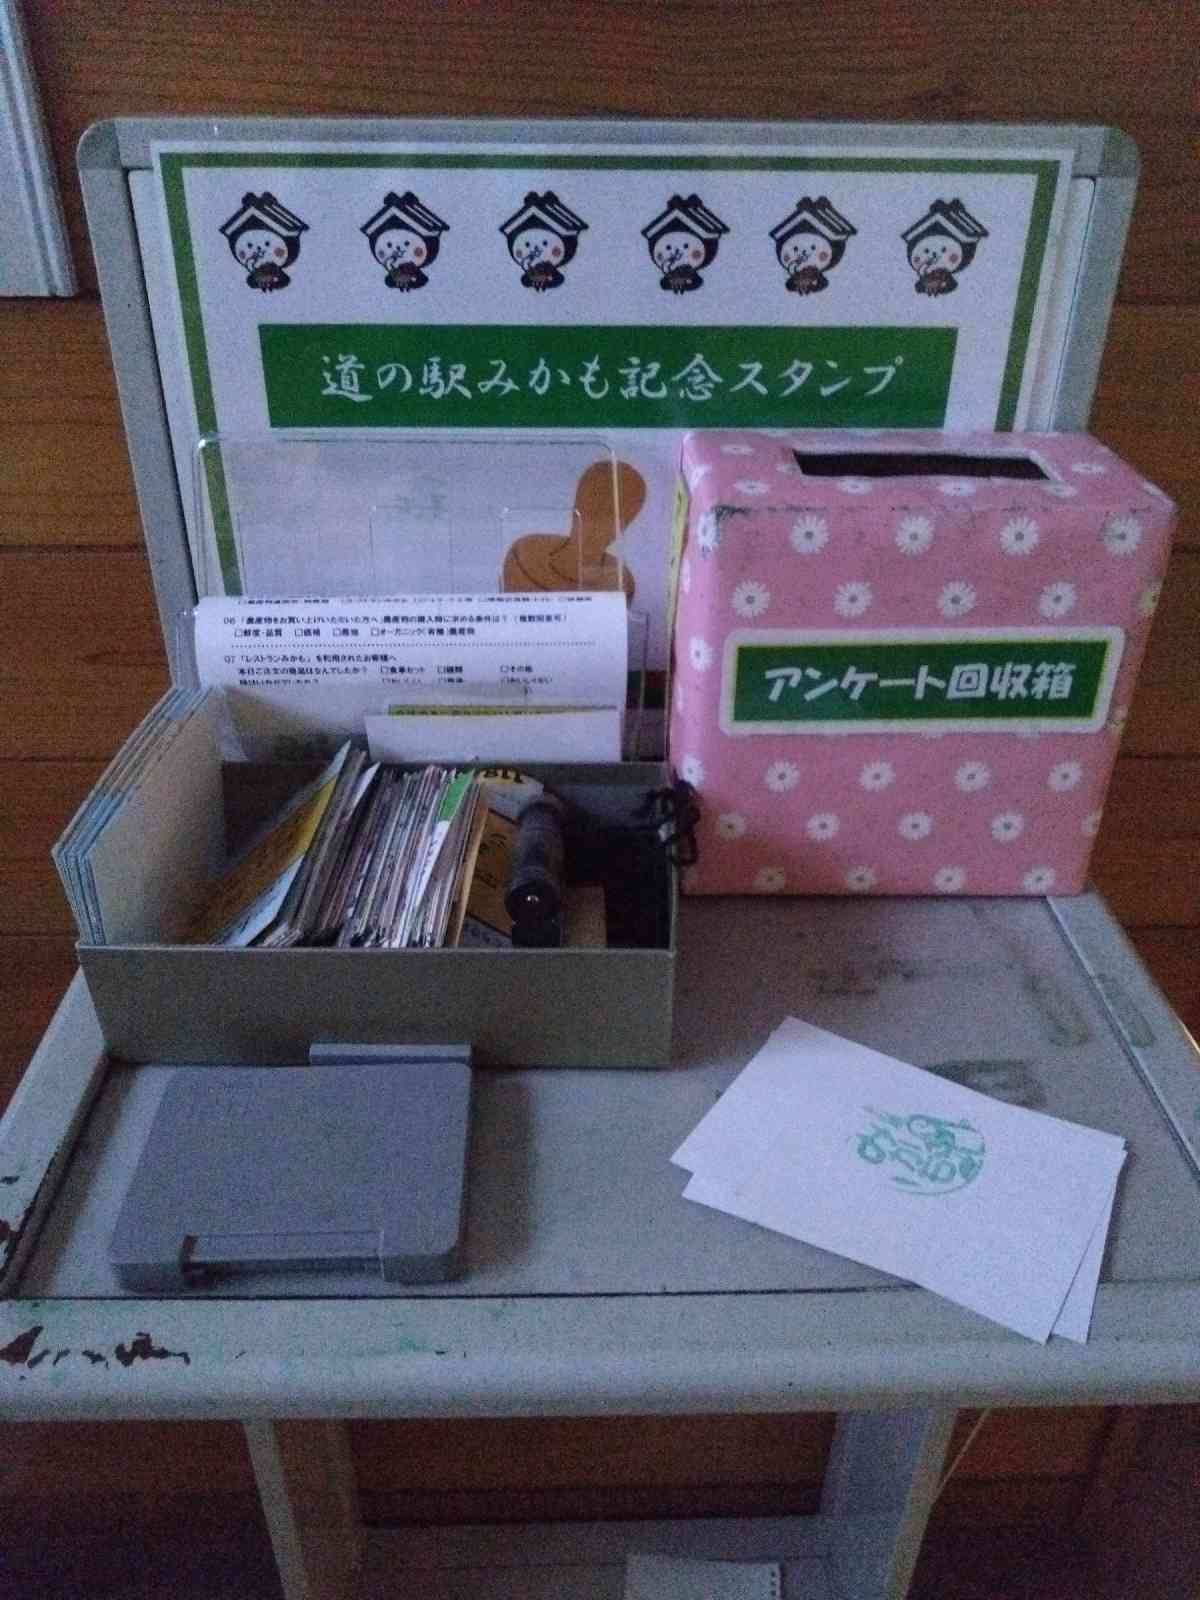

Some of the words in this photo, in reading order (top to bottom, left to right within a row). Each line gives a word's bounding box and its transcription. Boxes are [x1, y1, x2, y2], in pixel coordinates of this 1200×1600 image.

[320, 354, 904, 401] 道の駅みかも記念スタンプ
[764, 661, 1077, 701] アンケート回収箱
